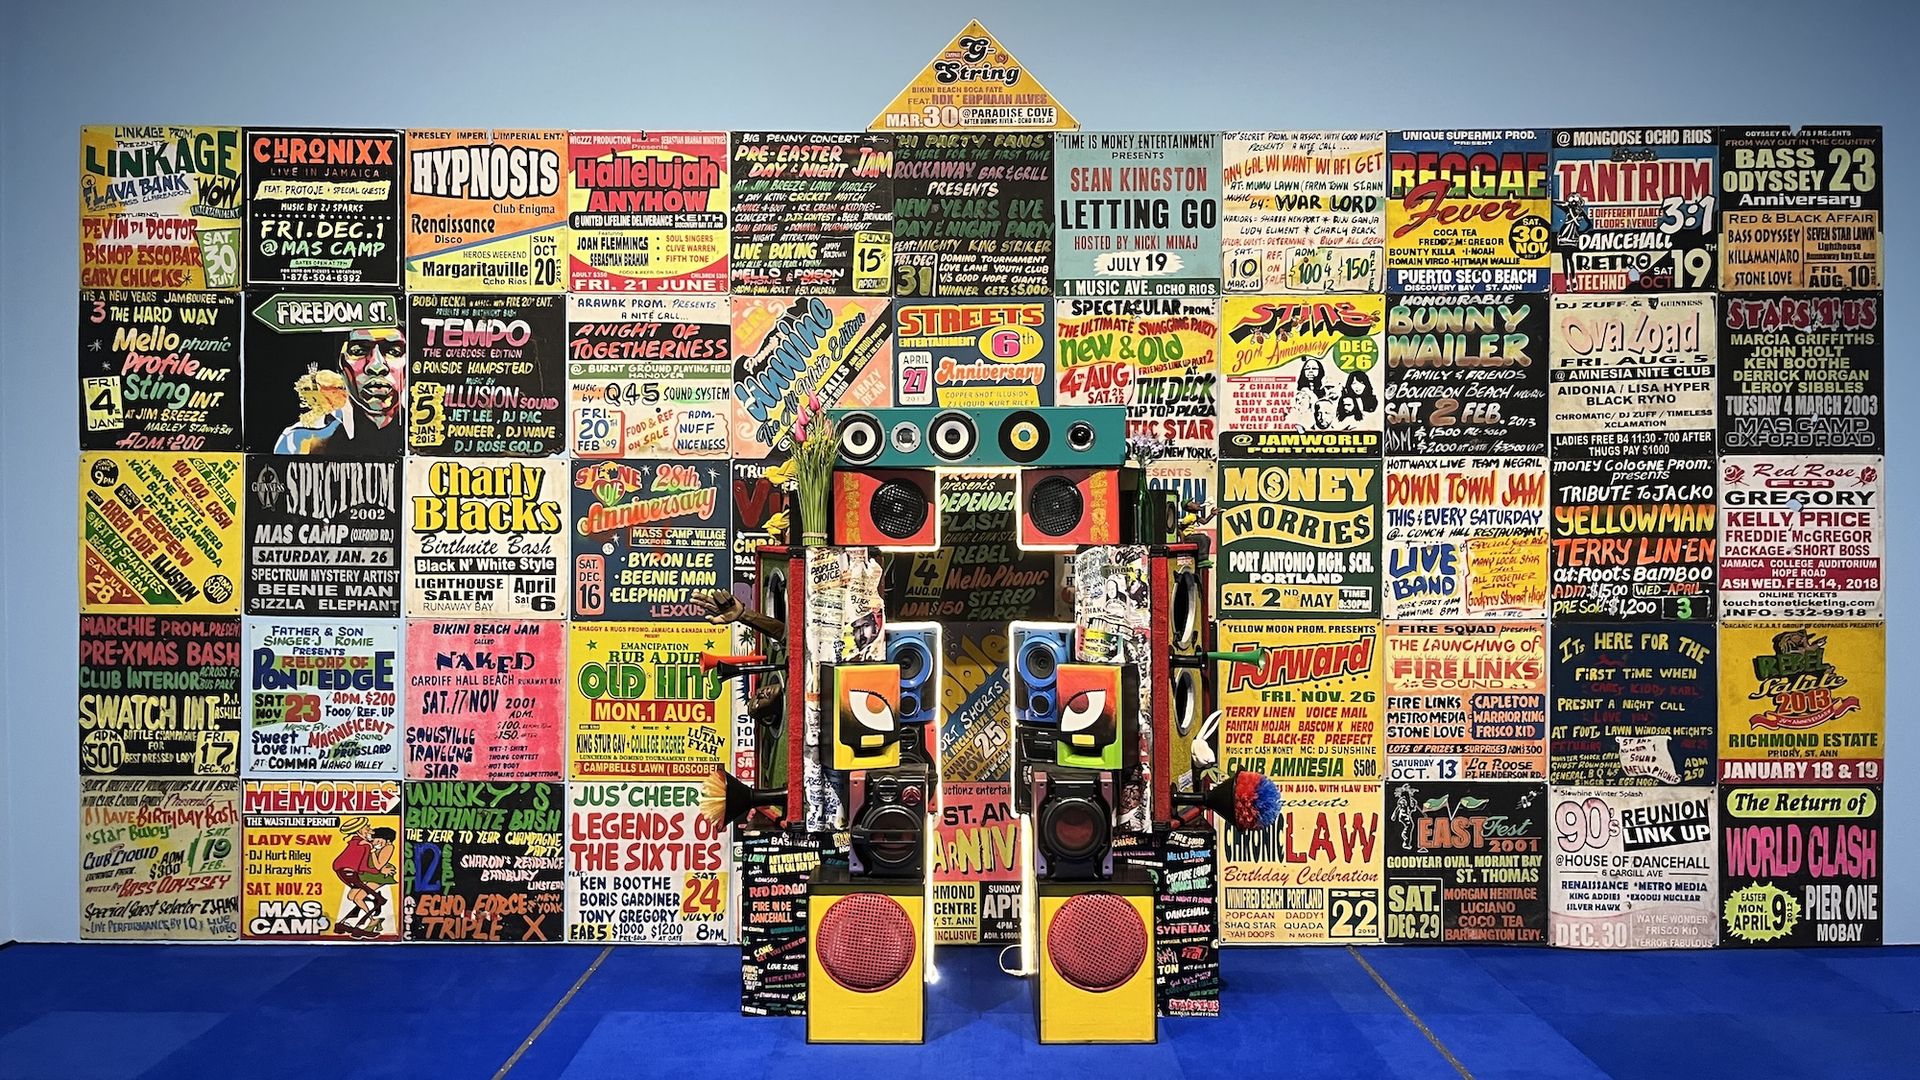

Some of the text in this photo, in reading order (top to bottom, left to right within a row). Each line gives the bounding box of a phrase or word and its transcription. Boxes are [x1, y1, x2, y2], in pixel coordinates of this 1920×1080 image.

[935, 61, 1021, 86] String
[1027, 108, 1054, 117] COVE
[115, 127, 165, 139] LINKAGE
[742, 134, 860, 144] BIG PENNY CONCERT
[1403, 131, 1537, 141] UNIQUE SUPERMIX PROD.
[1573, 129, 1712, 146] MONGOOSE OCHO RIOS
[86, 131, 238, 178] LINKAGE
[1111, 152, 1164, 160] PRESENTS
[1735, 148, 1815, 169] BASS
[413, 148, 558, 198] HYPNOSIS
[576, 158, 719, 190] Hallelujah
[1070, 167, 1207, 192] SEAN KINGSTON
[1558, 161, 1711, 203] TANTRUM
[1722, 170, 1824, 193] ODYSSEY
[928, 182, 1000, 197] PRESENTS
[281, 202, 305, 212] MUSIC
[308, 202, 318, 212] BY
[333, 202, 363, 213] SPARKS
[588, 191, 709, 212] ANYHOW
[1276, 197, 1377, 213] WAR LORD
[1739, 193, 1862, 208] Anniversary
[493, 204, 555, 215] Club Enigma
[1061, 199, 1217, 230] LETTING GO
[665, 234, 714, 243] SOUL SINGERS
[1074, 235, 1198, 250] HOSTED BY NICKI MINAJ
[82, 244, 202, 267] BISHOP ESCOBAR
[463, 250, 527, 260] HEROES WEEKEND
[734, 244, 764, 261] LIVE
[769, 242, 818, 260] BOXING
[1728, 250, 1799, 264] KILLAMANJARO
[423, 261, 529, 278] Margaritaville
[939, 263, 1049, 274] LOVE LANE YOUTH CLUB
[281, 274, 360, 282] 1-876-504-6992
[1399, 269, 1452, 284] PUERTO
[1495, 269, 1537, 284] BEACH
[575, 279, 716, 292] FRI. 21 JUNE
[277, 301, 393, 324] FREEDOM ST.
[1388, 305, 1531, 334] BUNNY
[898, 306, 1045, 336] STREETS
[421, 318, 532, 347] TEMPO
[1730, 333, 1875, 346] MARCIA GRIFFITHS
[570, 338, 729, 360] TOGETHERNESS
[1339, 341, 1377, 353] DEC.
[1387, 334, 1532, 367] WAILER
[1751, 346, 1844, 358] JOHN HOLT
[903, 355, 929, 364] APRIL
[1339, 354, 1371, 370] 26
[1568, 366, 1711, 380] AMNESIA NITE CLUB
[1586, 395, 1676, 405] BLACK RYNO
[679, 423, 714, 434] NUFF
[677, 439, 726, 450] NICENESS
[1257, 434, 1377, 446] JAMWORLD
[1247, 446, 1368, 454] PORTMORE
[429, 461, 545, 501] Charly
[286, 461, 396, 519] SPECTRUM
[1653, 484, 1713, 500] JACKO
[412, 496, 561, 533] Blacks
[1470, 509, 1543, 527] SATURDAY
[1727, 511, 1871, 527] KELLY PRICE
[1725, 530, 1872, 543] FREDDIE McGREGOR
[628, 553, 714, 567] BYRON LEE
[1249, 573, 1344, 584] PORTLAND
[87, 575, 112, 603] 28
[258, 584, 393, 597] BEENIE MAN
[423, 602, 493, 611] RUNAWAY BAY
[1300, 592, 1333, 607] MAY
[1722, 599, 1876, 608] touchstoneticketing.com
[272, 626, 320, 637] FATHER
[433, 624, 540, 635] BIKINI BEACH JAM
[621, 642, 689, 651] EMANCIPATION
[411, 674, 515, 686] CARDIFF HALL BEACH
[1660, 668, 1697, 680] WHEN
[1261, 690, 1376, 703] FRI. NOV. 26
[1474, 696, 1539, 709] CAPLETON
[80, 694, 181, 729] SWATCH
[1305, 706, 1368, 718] VOICE MAIL
[1728, 733, 1878, 748] RICHMOND ESTATE
[583, 763, 665, 774] CAMPBELLS LAWN
[1723, 761, 1832, 779] JANUARY 18
[245, 781, 401, 814] MEMORIES
[1621, 798, 1710, 828] REUNION
[572, 812, 685, 841] LEGENDS
[248, 834, 332, 846] LADY SAW
[1285, 812, 1379, 864] LAW
[1488, 839, 1539, 853] 2001
[1725, 824, 1877, 880] WORLD CLASH
[1224, 865, 1379, 886] Birthday Celebration
[580, 876, 671, 890] KEN BOOTHE
[1639, 881, 1708, 892] METRO MEDIA
[935, 901, 977, 915] CENTRE
[1461, 901, 1516, 914] LUCIANO
[1225, 911, 1276, 919] POPCAAN
[1816, 924, 1863, 942] MOBAY
